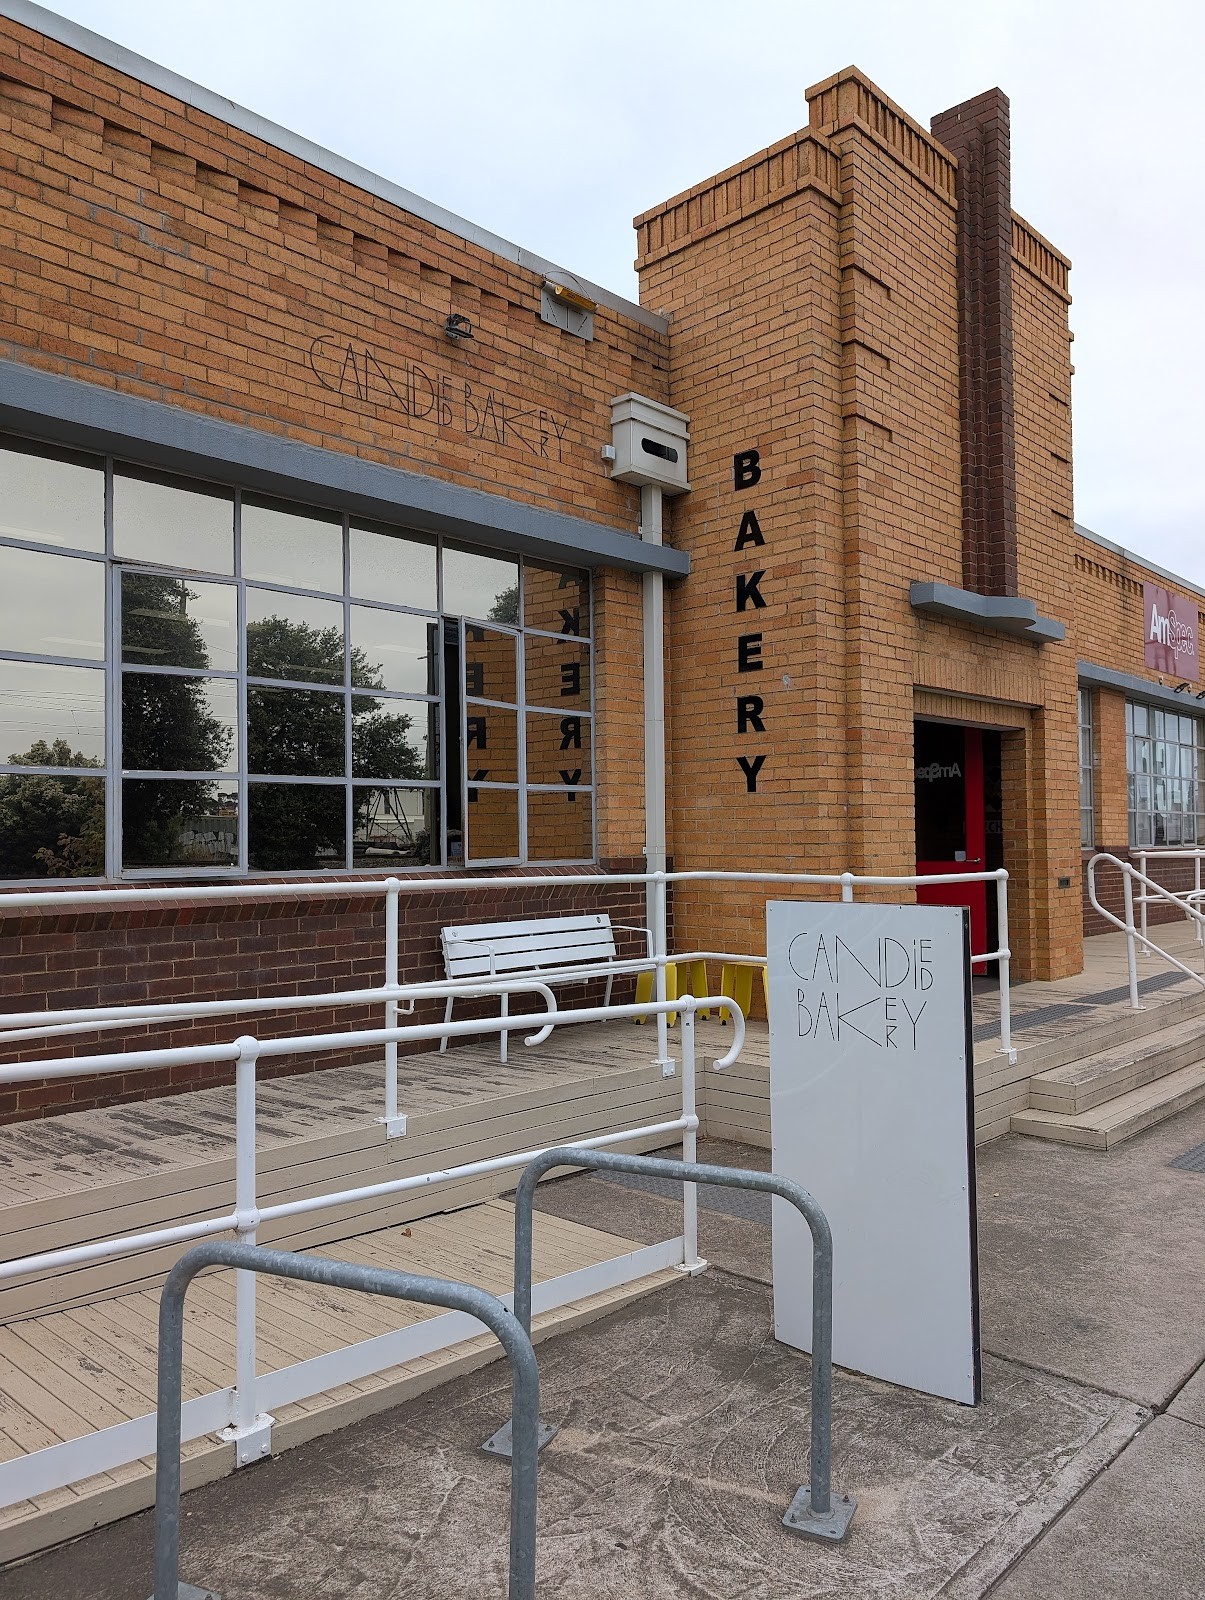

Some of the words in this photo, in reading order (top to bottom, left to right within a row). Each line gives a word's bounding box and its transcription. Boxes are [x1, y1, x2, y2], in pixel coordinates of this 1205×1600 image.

[464, 380, 568, 463] BAKERY
[733, 449, 767, 793] BAKERY
[1150, 603, 1194, 660] AmSpec
[797, 988, 928, 1051] BAKERY
